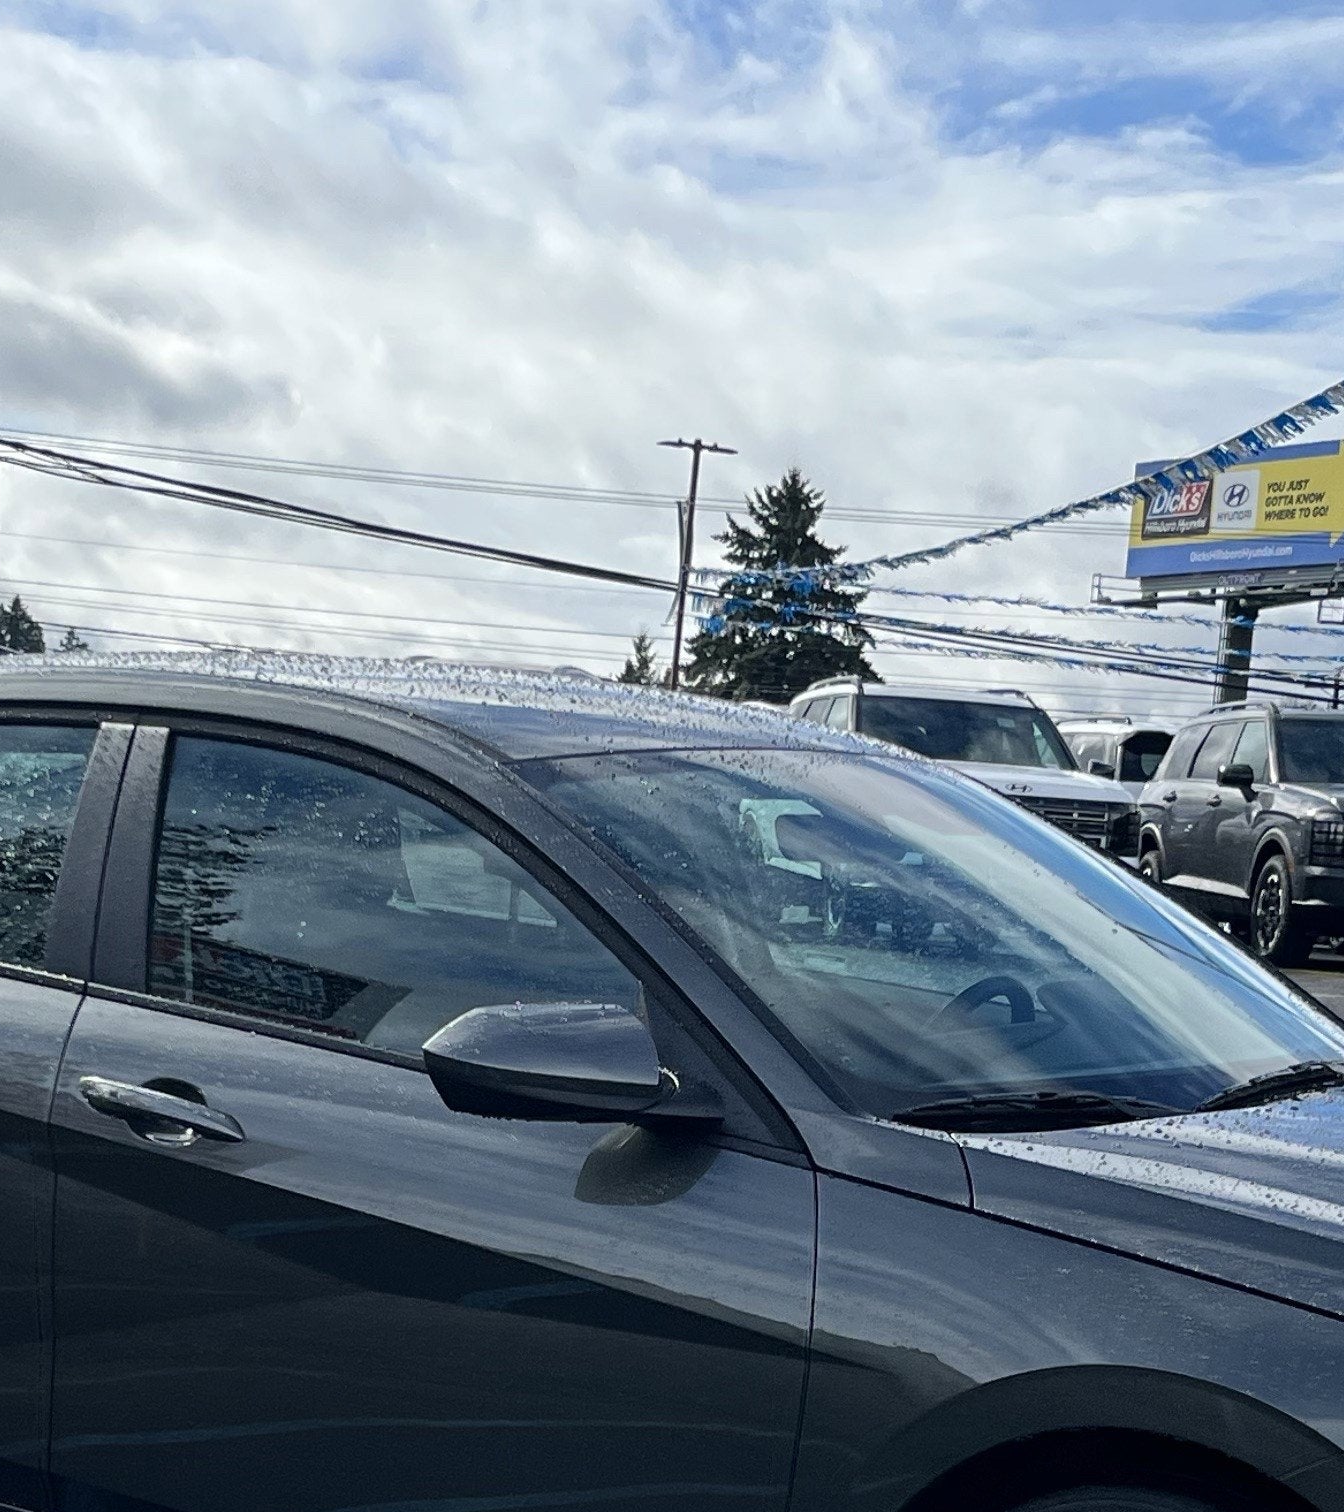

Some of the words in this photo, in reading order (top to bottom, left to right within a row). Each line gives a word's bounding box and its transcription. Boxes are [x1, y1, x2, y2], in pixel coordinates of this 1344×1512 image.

[1267, 482, 1285, 493] YOU
[1287, 479, 1310, 491] JUST
[1265, 495, 1294, 507] GOTTA
[1295, 492, 1326, 505] KNOW
[1264, 508, 1296, 521] WHERE
[1298, 508, 1310, 519] TO
[1312, 506, 1329, 518] GO!
